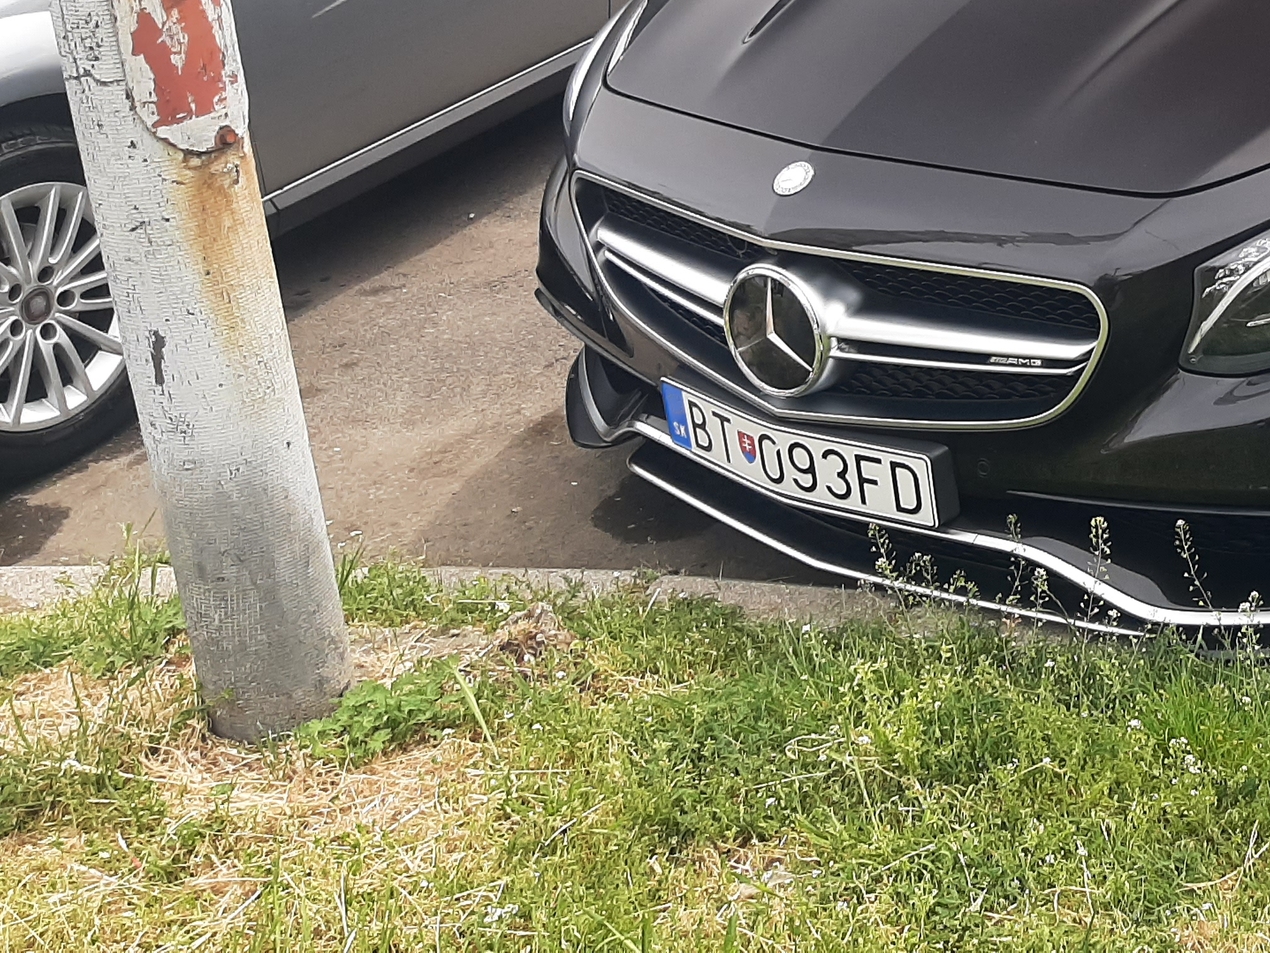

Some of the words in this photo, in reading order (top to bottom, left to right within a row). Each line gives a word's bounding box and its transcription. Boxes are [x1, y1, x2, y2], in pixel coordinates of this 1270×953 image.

[673, 421, 687, 439] SK
[687, 398, 732, 464] BT
[757, 433, 923, 515] 093FD
